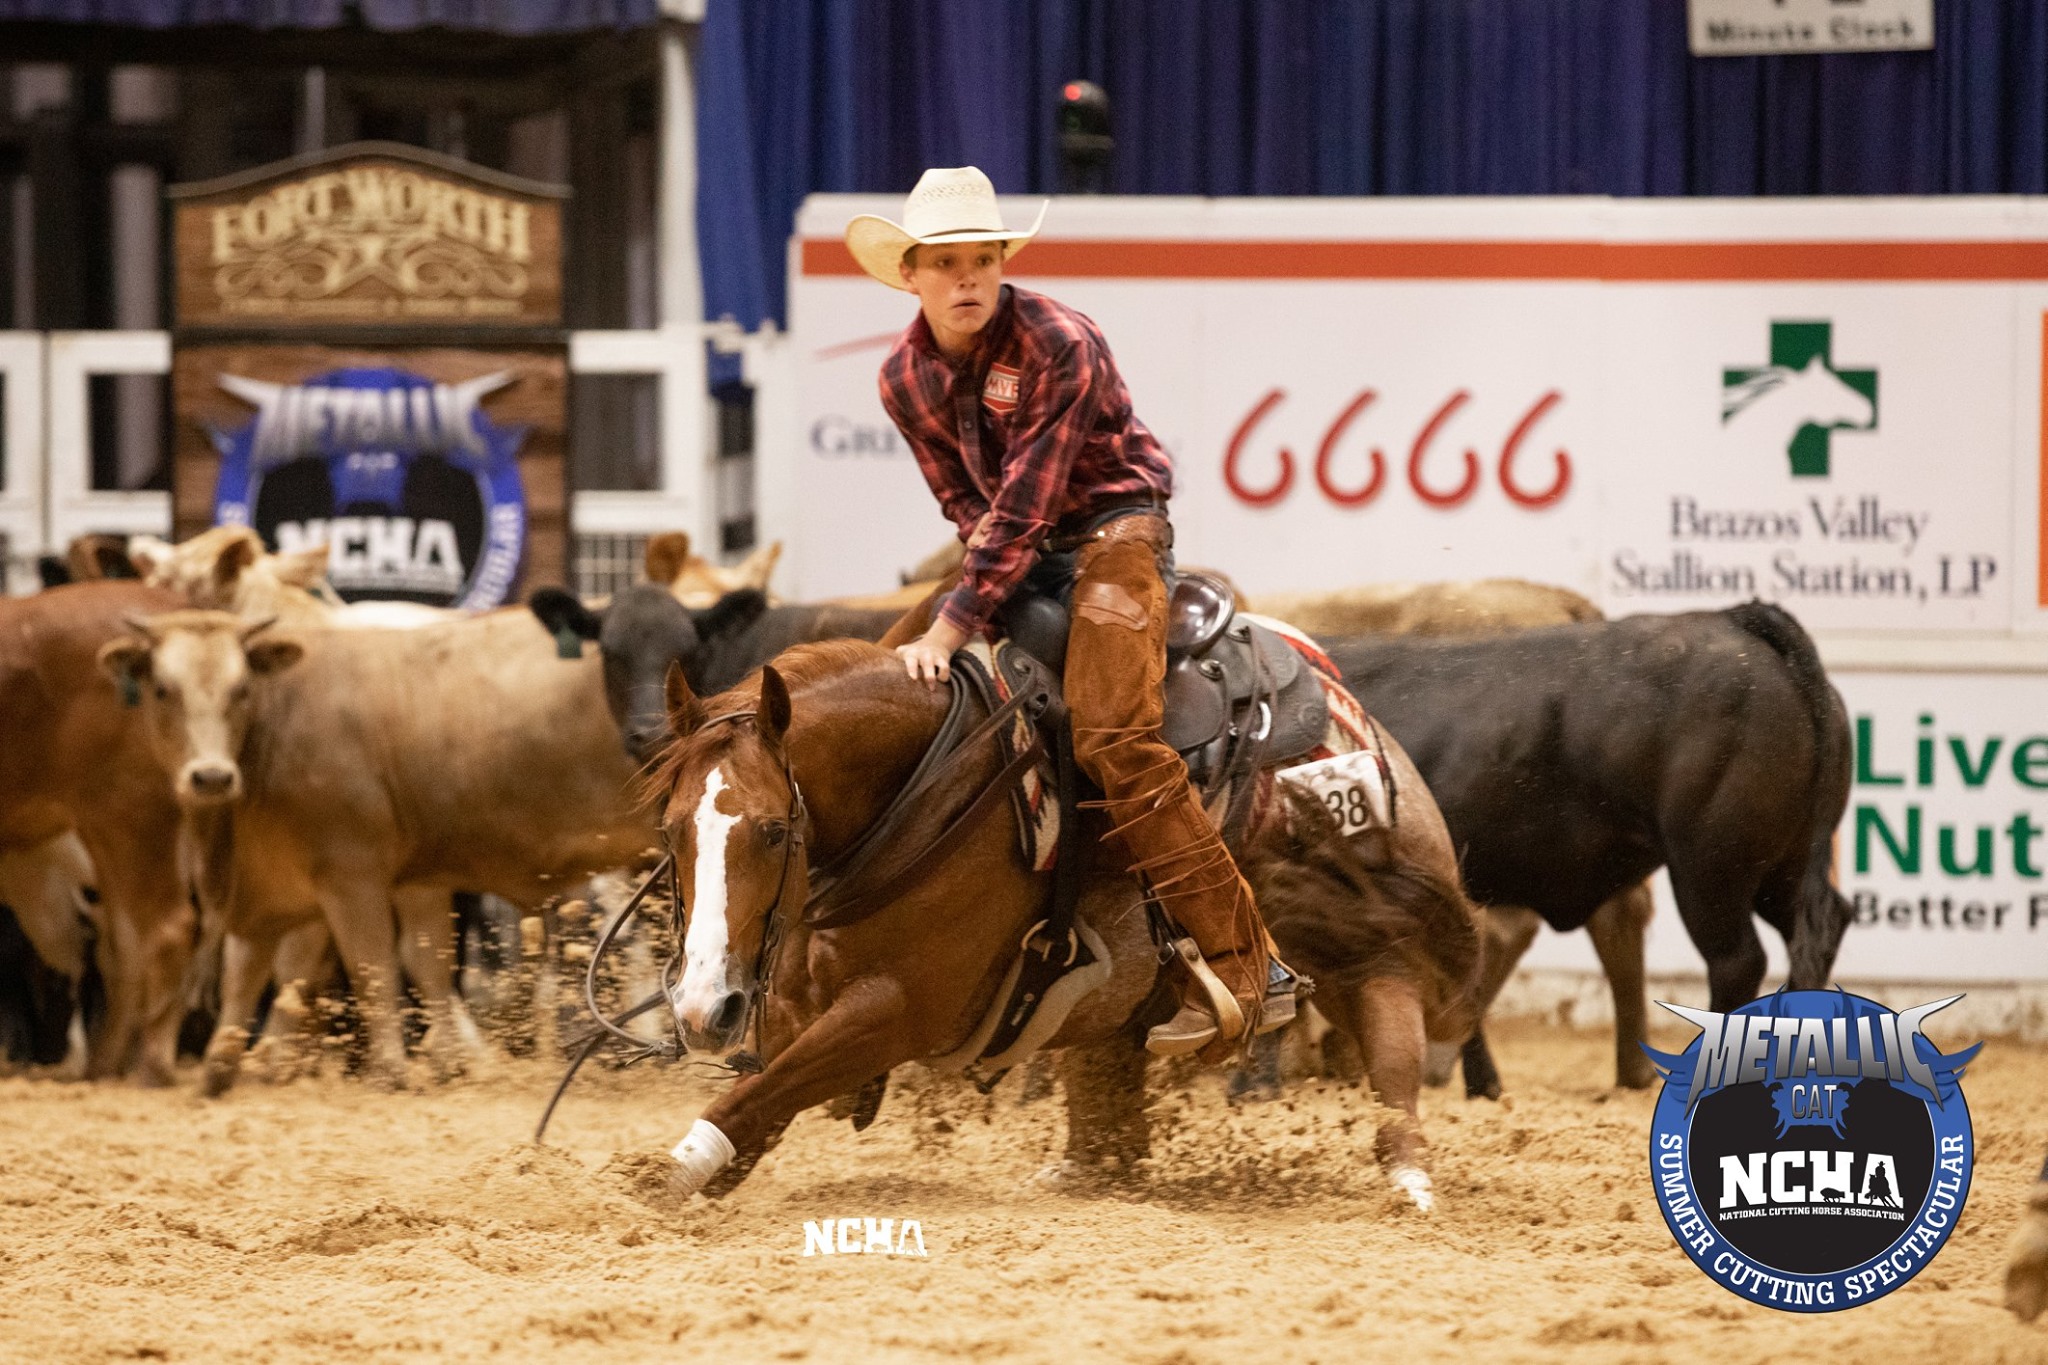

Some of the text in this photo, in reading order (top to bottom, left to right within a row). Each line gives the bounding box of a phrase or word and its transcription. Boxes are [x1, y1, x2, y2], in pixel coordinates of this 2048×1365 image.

[212, 168, 530, 263] FORT WORTH
[1223, 388, 1573, 512] 6666
[1669, 497, 1929, 556] Brazos Valley
[1612, 550, 1996, 602] Stallion Station, LP
[1855, 712, 2048, 789] Live
[1326, 784, 1368, 831] 38
[1852, 890, 2011, 929] Better
